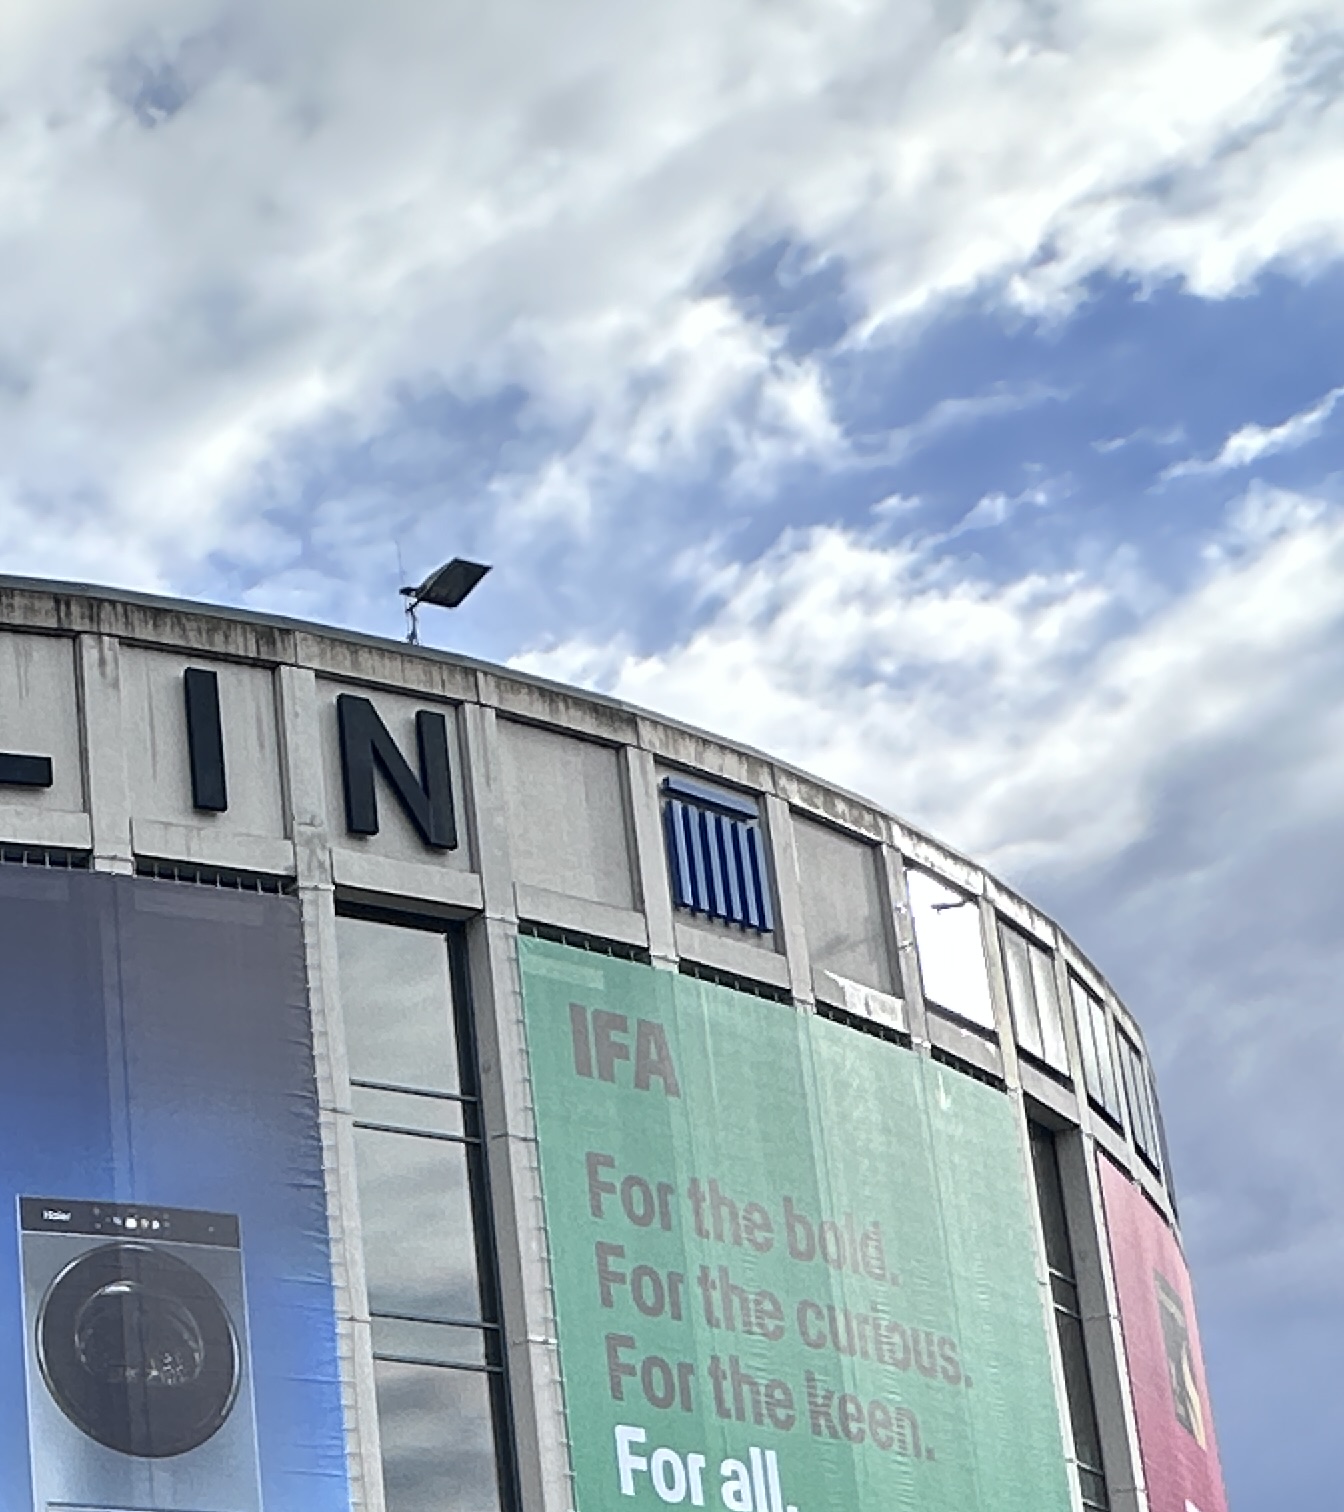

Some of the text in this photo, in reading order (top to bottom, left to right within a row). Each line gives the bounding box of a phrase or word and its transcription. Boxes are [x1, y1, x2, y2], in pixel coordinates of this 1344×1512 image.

[569, 1003, 681, 1098] IFA
[585, 1151, 900, 1286] For the bold.
[594, 1242, 973, 1389] For the curious.
[606, 1334, 937, 1462] For the keen.
[614, 1425, 706, 1507] For
